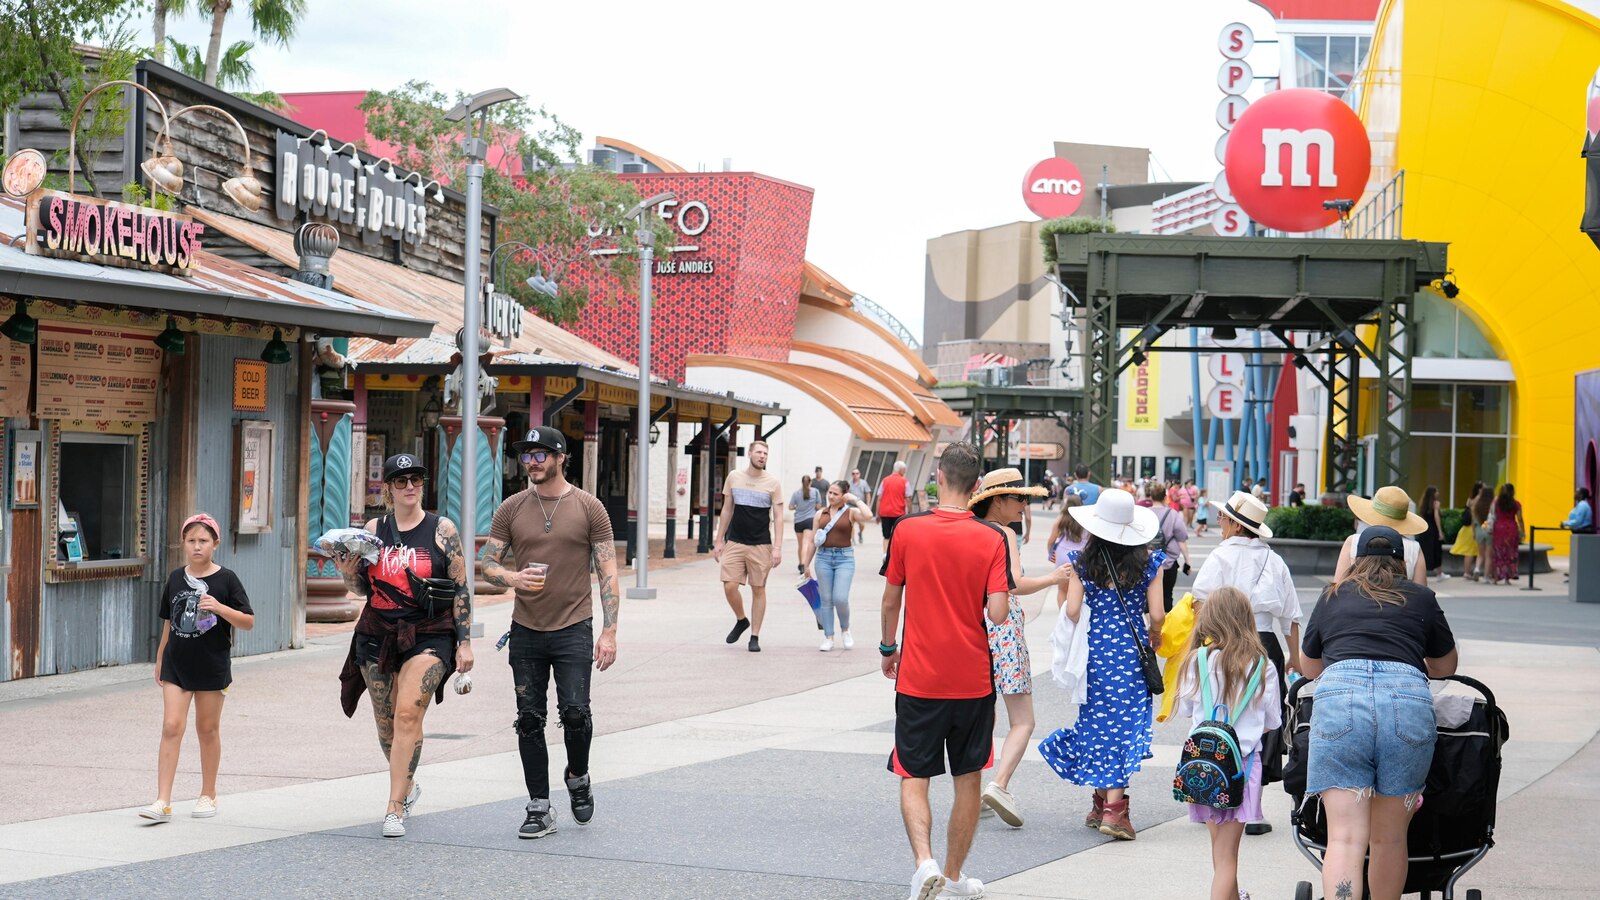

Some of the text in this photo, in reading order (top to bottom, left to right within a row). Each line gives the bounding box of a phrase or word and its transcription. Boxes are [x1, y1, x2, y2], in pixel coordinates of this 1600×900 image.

[1261, 128, 1337, 188] m
[282, 151, 355, 214] HOUSE
[368, 187, 426, 238] BLUES
[1031, 178, 1081, 196] amc
[46, 196, 205, 270] SMOKEHOUSE
[241, 389, 260, 401] BEER
[242, 370, 260, 383] COLD
